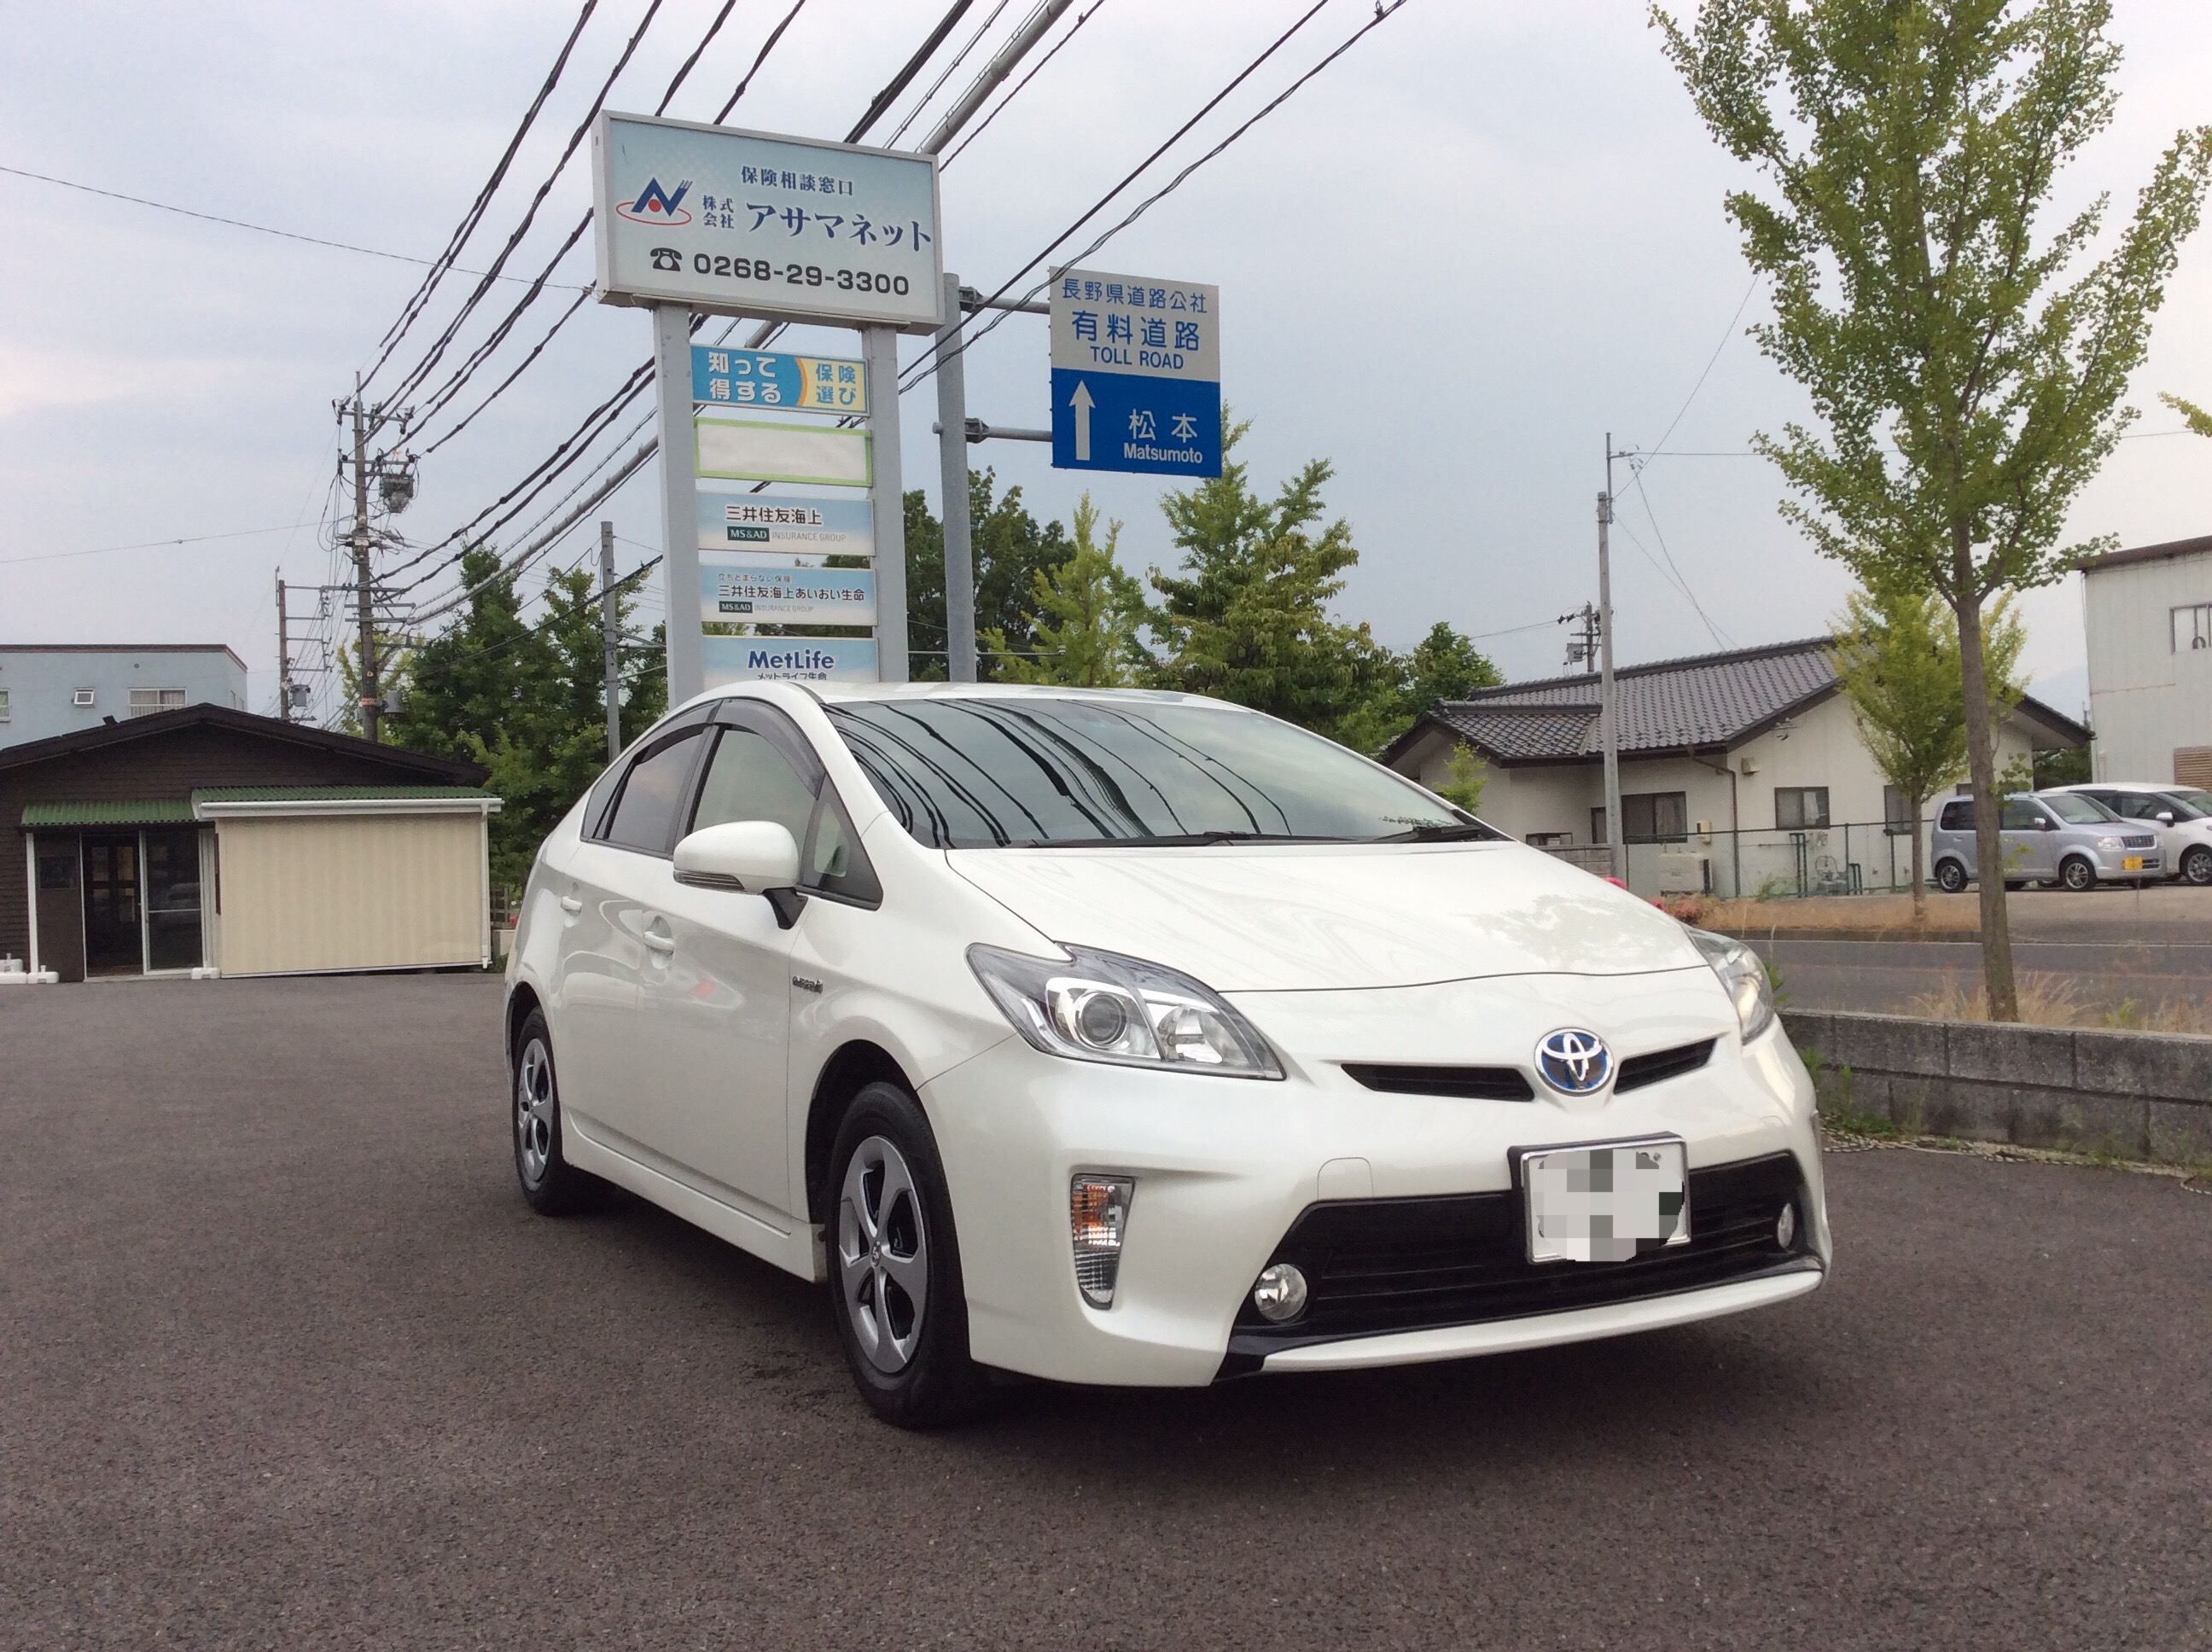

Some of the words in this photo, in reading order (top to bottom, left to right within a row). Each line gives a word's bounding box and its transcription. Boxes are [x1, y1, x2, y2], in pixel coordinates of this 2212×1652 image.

[741, 166, 853, 196] 保険相談窓口
[702, 195, 735, 212] 株式
[703, 212, 735, 230] 会社
[746, 202, 932, 252] アサマネット
[694, 253, 910, 295] 0268-29-3300
[1062, 278, 1208, 314] 長野県道路公社
[1072, 310, 1200, 352] 有料道路
[708, 352, 777, 378] 知って
[1090, 346, 1132, 365] TOLL
[1139, 351, 1184, 369] ROAD
[816, 364, 856, 385] 保険
[709, 378, 782, 404] 得する
[817, 386, 857, 406] 選び
[1128, 409, 1197, 444] 松本
[1124, 442, 1203, 463] Matsumoto
[726, 506, 823, 526] 三井住友海上
[730, 528, 767, 539] MS&AD
[771, 531, 818, 541] INSURANCE
[819, 533, 847, 542] GROUP
[719, 585, 865, 602] 三井住友海上あいおい生命
[721, 602, 751, 611] MS&AD
[748, 649, 835, 670] MetLife
